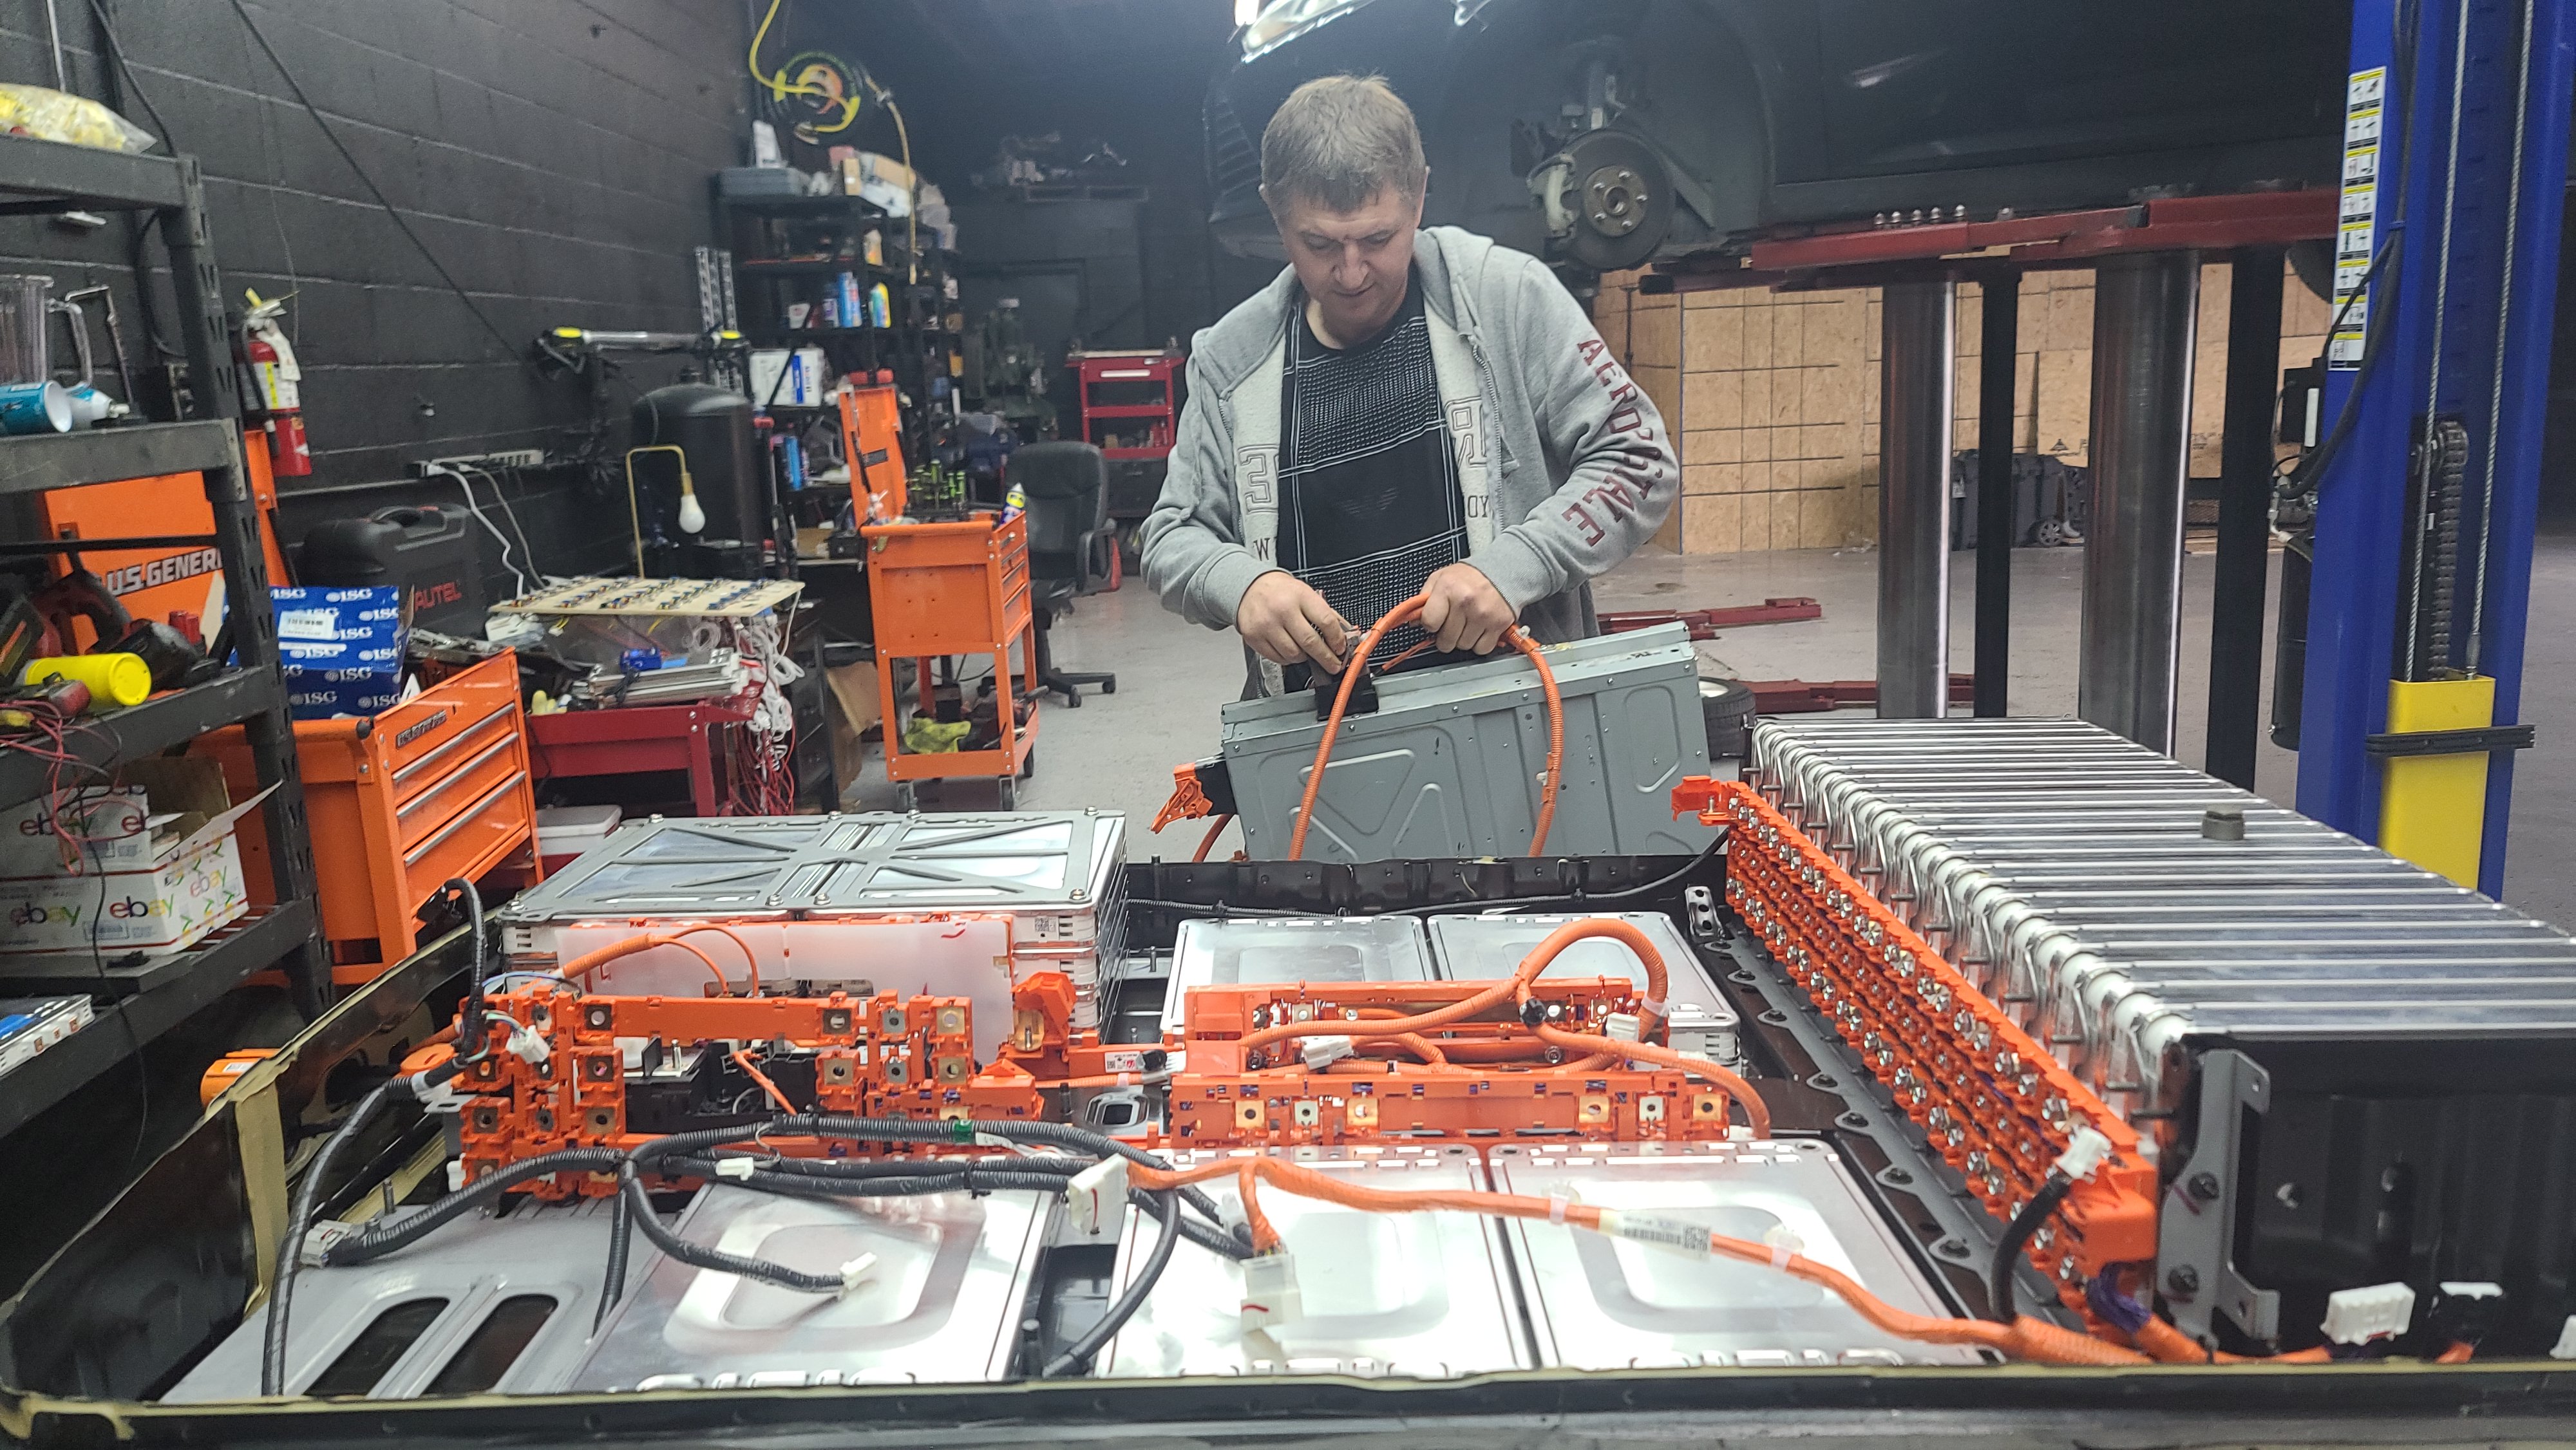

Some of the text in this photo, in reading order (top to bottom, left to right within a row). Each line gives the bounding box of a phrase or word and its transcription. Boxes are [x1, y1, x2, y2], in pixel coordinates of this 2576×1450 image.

[340, 587, 373, 602] ISG
[340, 626, 373, 640] ISG
[339, 666, 372, 681] ISG
[305, 691, 337, 704] ISG
[190, 865, 227, 897] ebay
[109, 894, 173, 918] ebay
[10, 902, 81, 927] ebay
